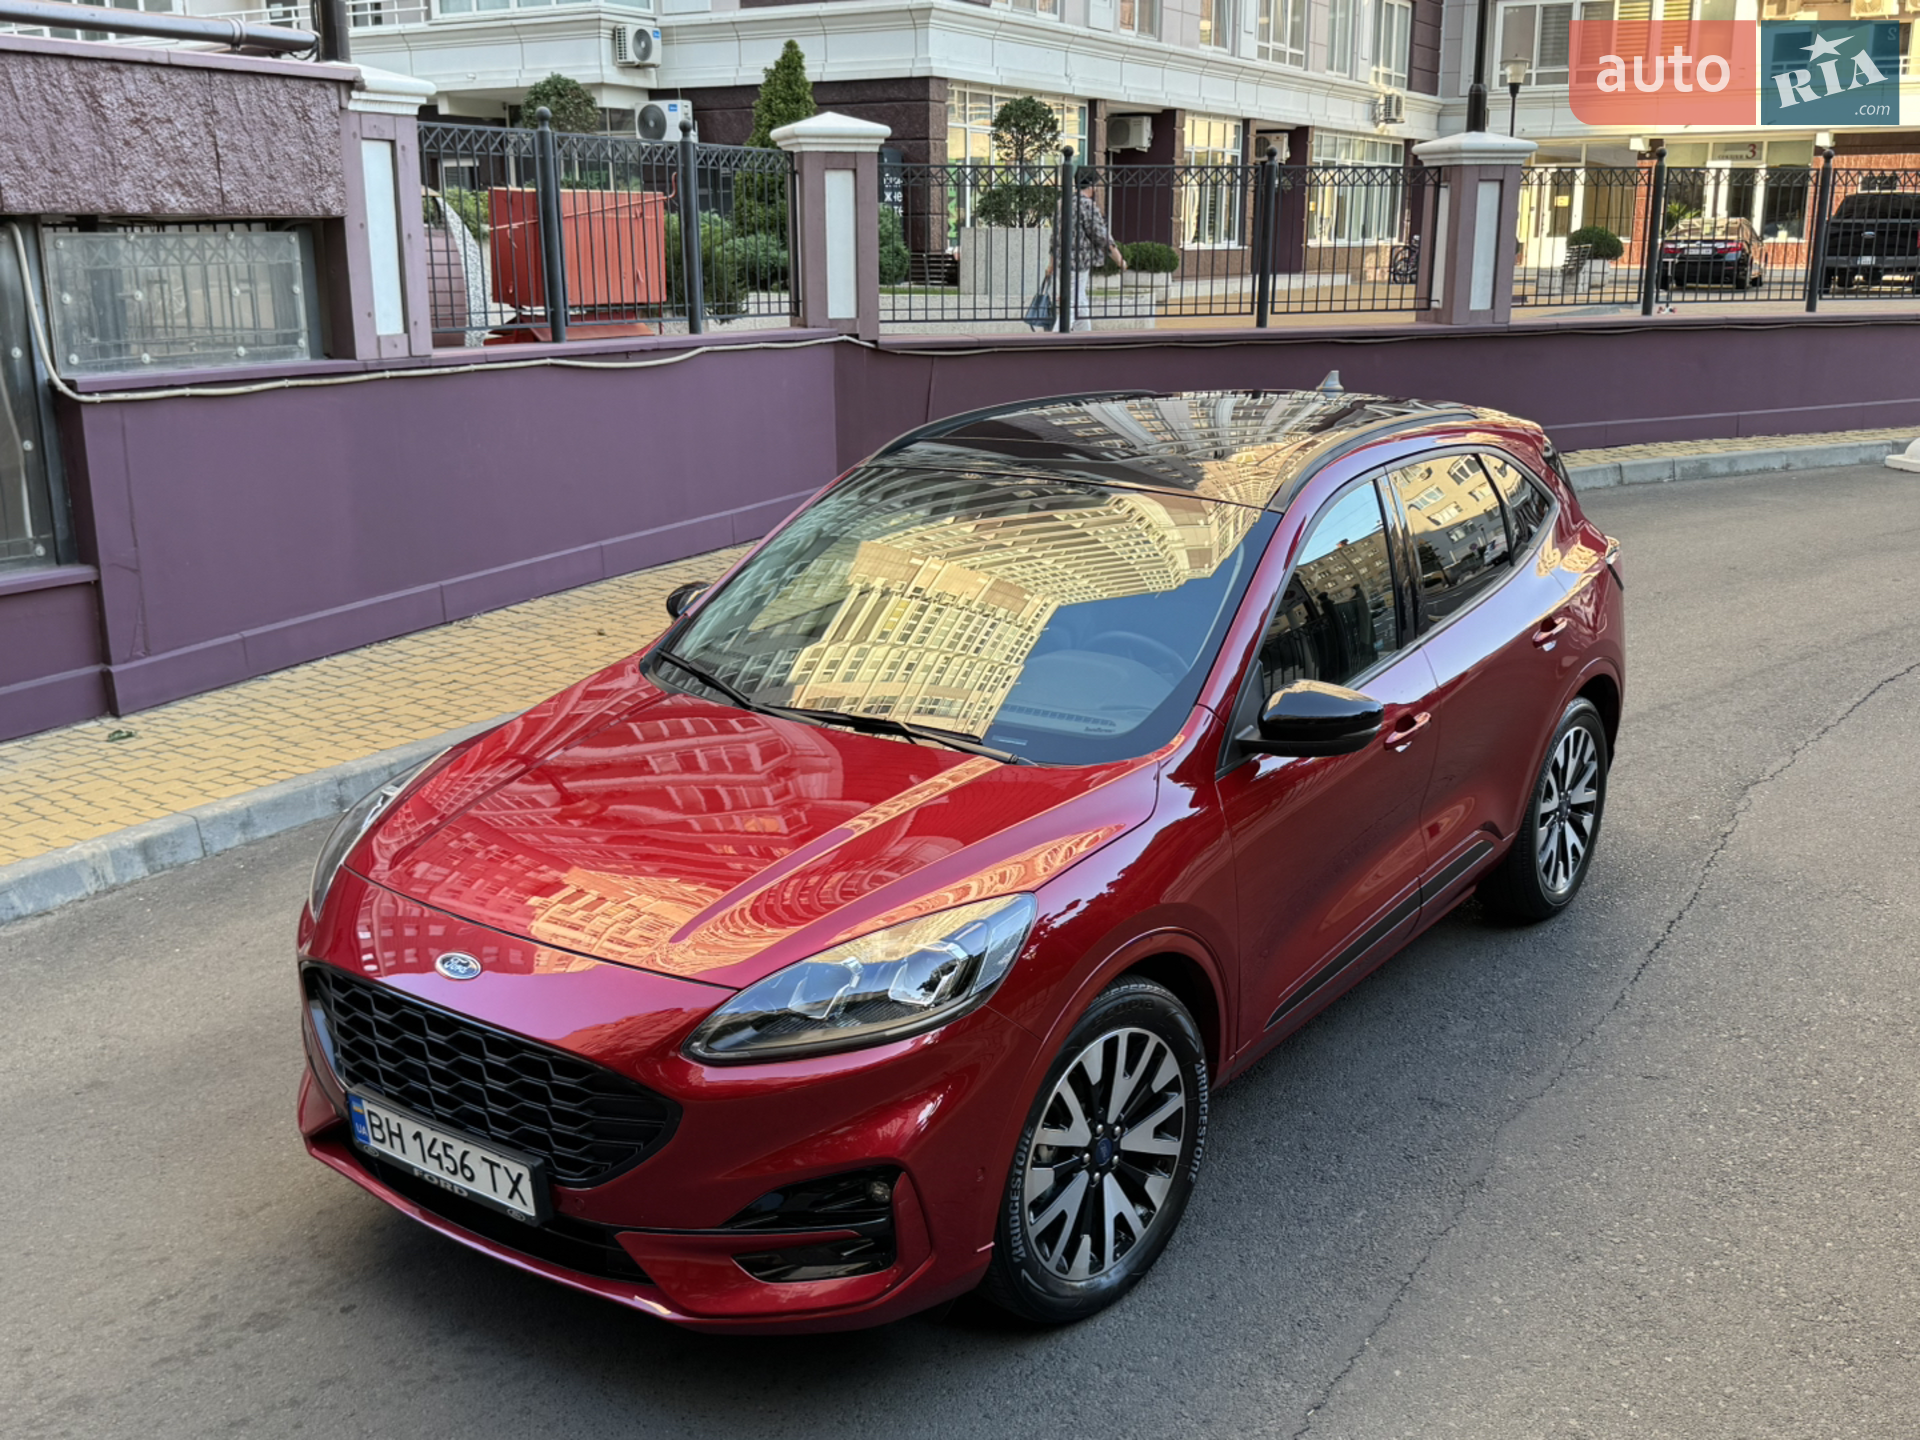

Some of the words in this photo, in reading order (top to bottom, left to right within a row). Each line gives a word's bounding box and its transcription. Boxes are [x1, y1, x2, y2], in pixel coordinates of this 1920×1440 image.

[1746, 143, 1757, 159] 3
[355, 1122, 369, 1137] UA
[1187, 1059, 1209, 1183] BRIDGESTONE
[367, 1109, 406, 1155] BH
[412, 1130, 475, 1183] 1456
[481, 1155, 529, 1206] TX
[413, 1167, 469, 1197] FORD
[1009, 1126, 1034, 1263] BRIDGESTONE
